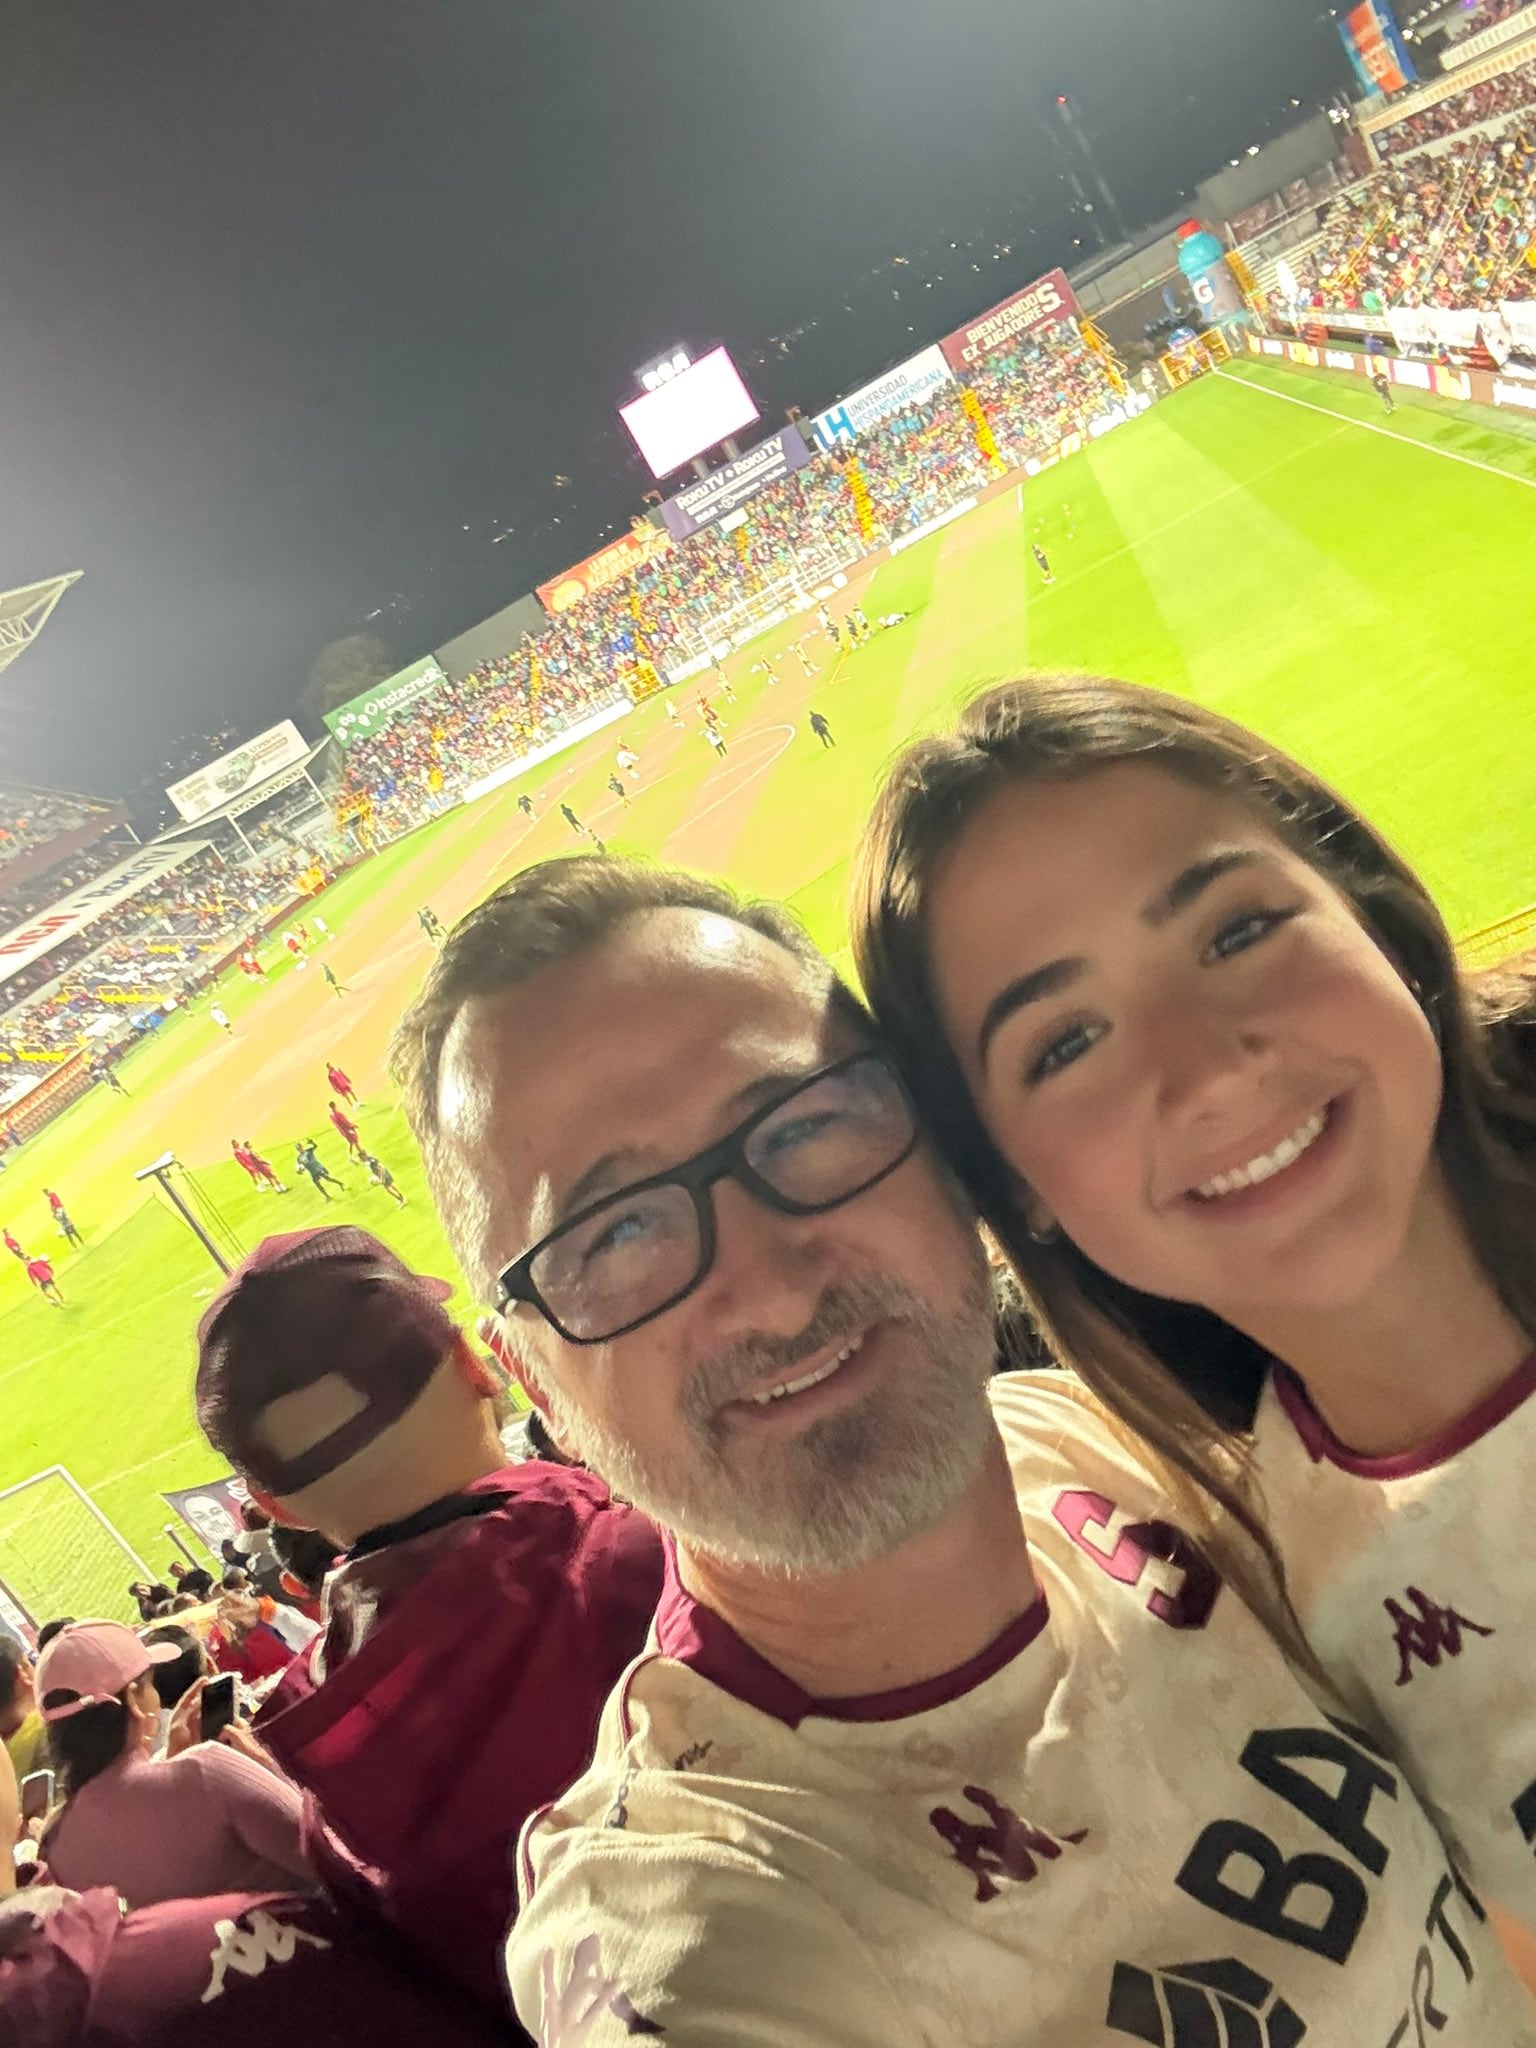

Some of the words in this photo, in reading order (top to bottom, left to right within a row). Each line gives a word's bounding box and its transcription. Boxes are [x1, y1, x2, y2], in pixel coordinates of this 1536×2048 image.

[961, 345, 981, 362] EX
[849, 375, 908, 416] UNIVERSIDAD
[1174, 1712, 1400, 1967] BA
